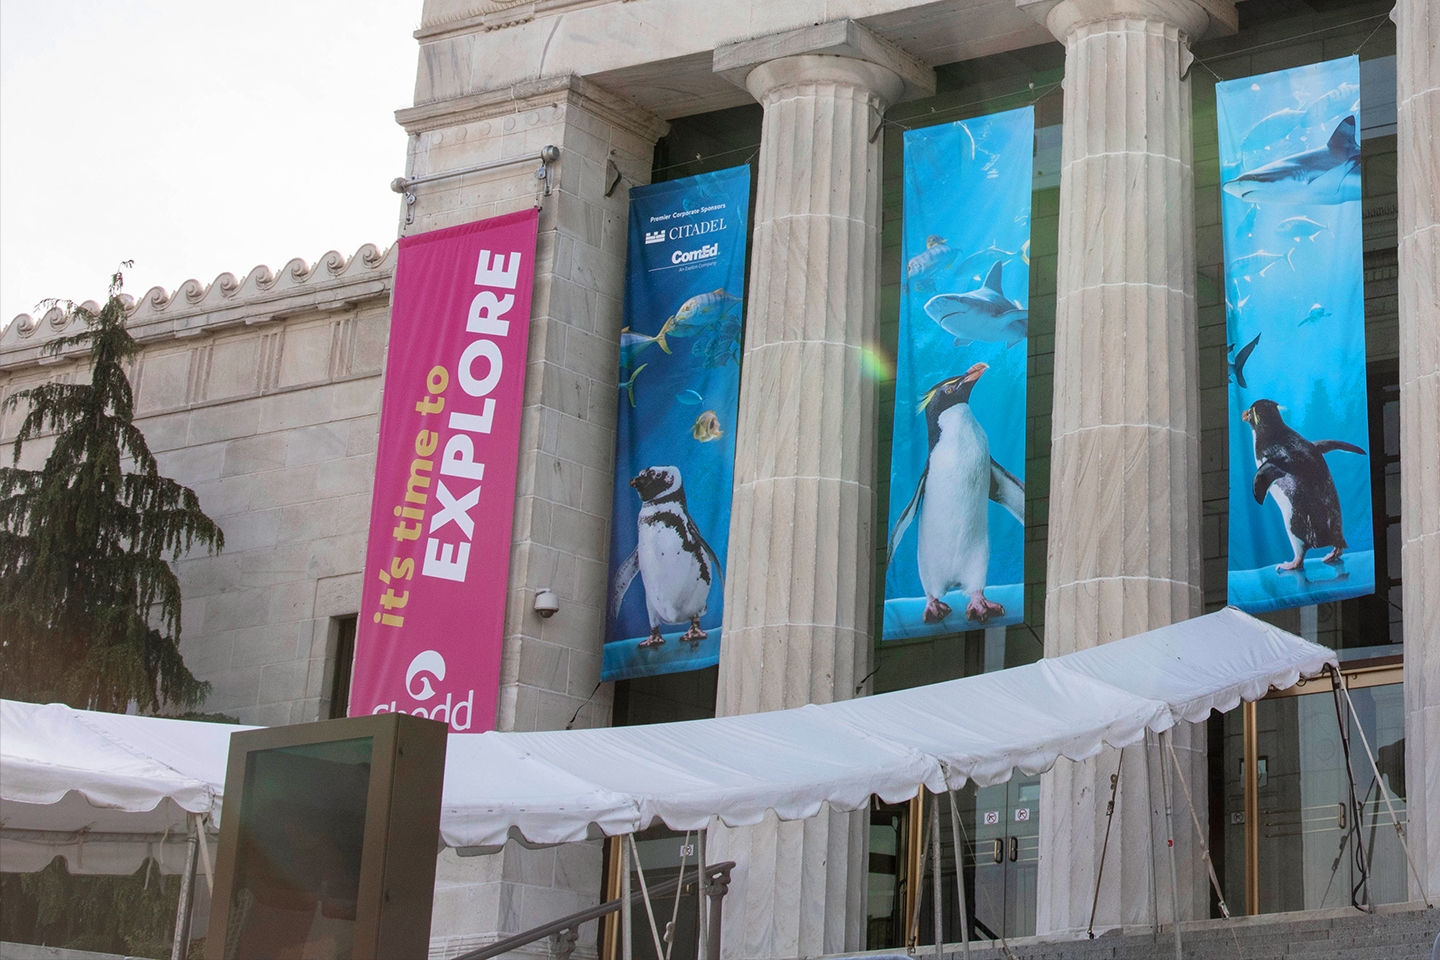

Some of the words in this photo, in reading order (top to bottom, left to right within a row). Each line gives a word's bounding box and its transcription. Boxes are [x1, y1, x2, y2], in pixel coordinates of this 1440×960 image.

[650, 214, 671, 223] Premier
[672, 208, 700, 219] Corporate
[700, 203, 726, 213] Sponsors
[669, 218, 727, 240] CITADEL
[671, 243, 719, 264] ComEd
[415, 365, 449, 416] to
[422, 249, 522, 582] EXPLORE
[393, 429, 438, 542] time
[373, 557, 415, 627] it's
